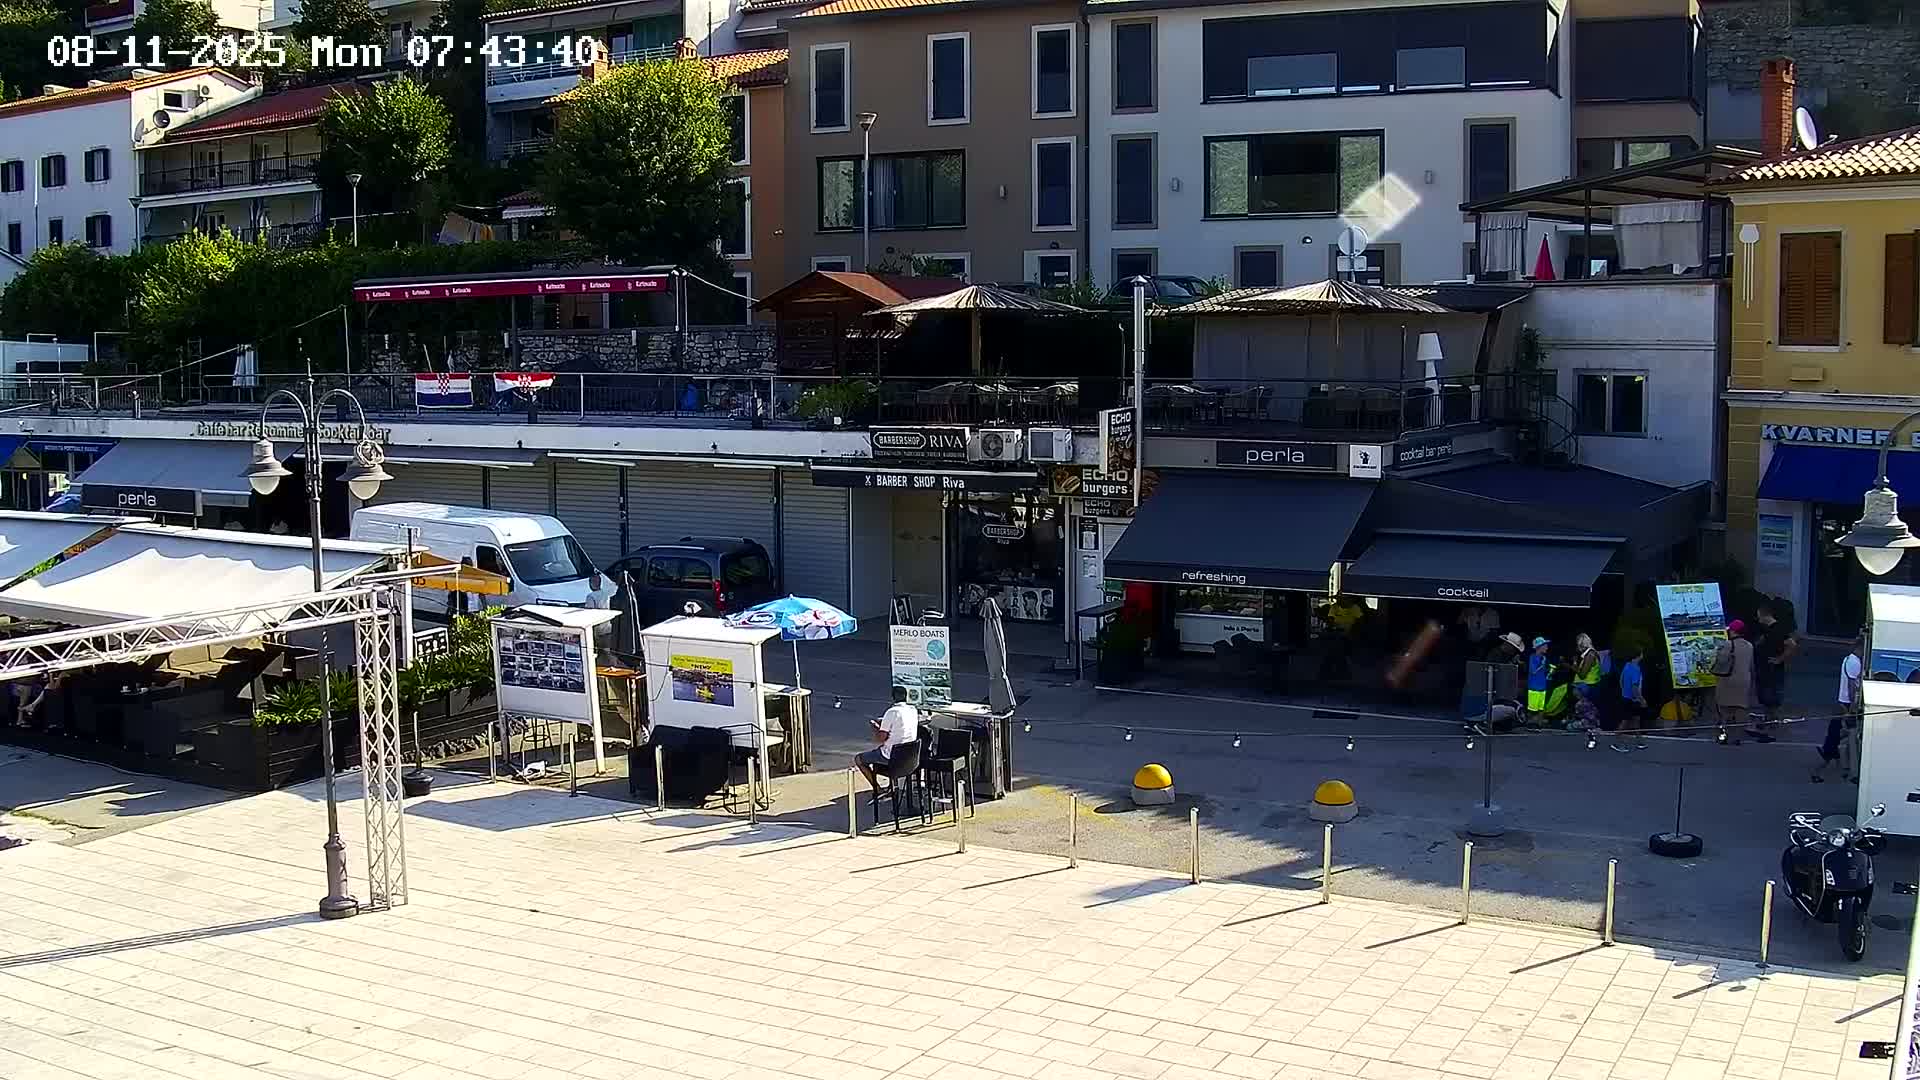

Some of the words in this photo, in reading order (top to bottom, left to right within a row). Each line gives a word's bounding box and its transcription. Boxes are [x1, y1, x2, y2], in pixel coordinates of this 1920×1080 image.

[1110, 411, 1131, 425] ECHO
[879, 435, 921, 445] BARBERSHOP
[929, 434, 964, 449] RIVA
[1246, 447, 1305, 464] perla
[876, 474, 908, 487] BARBER
[913, 475, 936, 488] SHOP
[942, 476, 965, 489] Riva
[1082, 481, 1128, 496] burgers
[118, 491, 157, 507] perla
[1182, 570, 1246, 584] refreshing
[1437, 587, 1489, 598] cocktail
[893, 629, 919, 637] MERLO
[920, 629, 945, 638] BOATS
